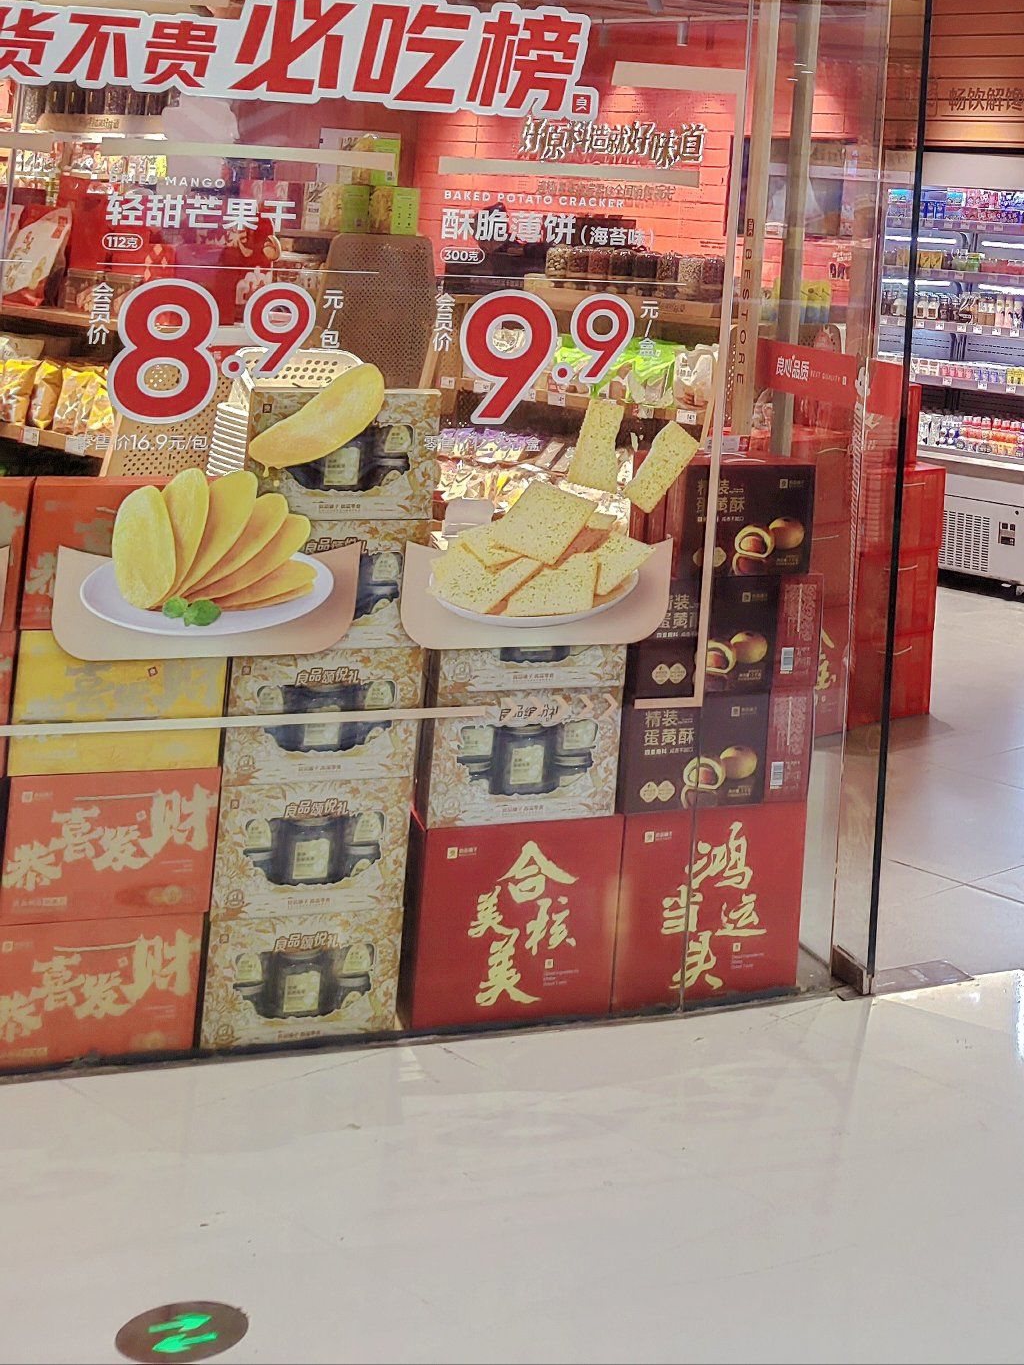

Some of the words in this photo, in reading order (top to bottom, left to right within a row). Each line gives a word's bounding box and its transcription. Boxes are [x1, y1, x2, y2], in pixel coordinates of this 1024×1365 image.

[166, 176, 226, 189] MANGO
[444, 190, 490, 203] BAKED
[498, 193, 552, 206] POTATO
[559, 195, 625, 209] CRACKER
[106, 192, 297, 234] 轻甜芒果干
[441, 208, 577, 243] 酥脆薄饼
[106, 236, 139, 250] 112克
[444, 248, 480, 262] 300克
[87, 282, 114, 346] 会员价
[433, 292, 456, 353] 会员价
[736, 248, 753, 385] BESTORE
[110, 281, 314, 422] 8.9
[461, 290, 634, 423] 9.9
[643, 727, 695, 747] 蛋黄酥
